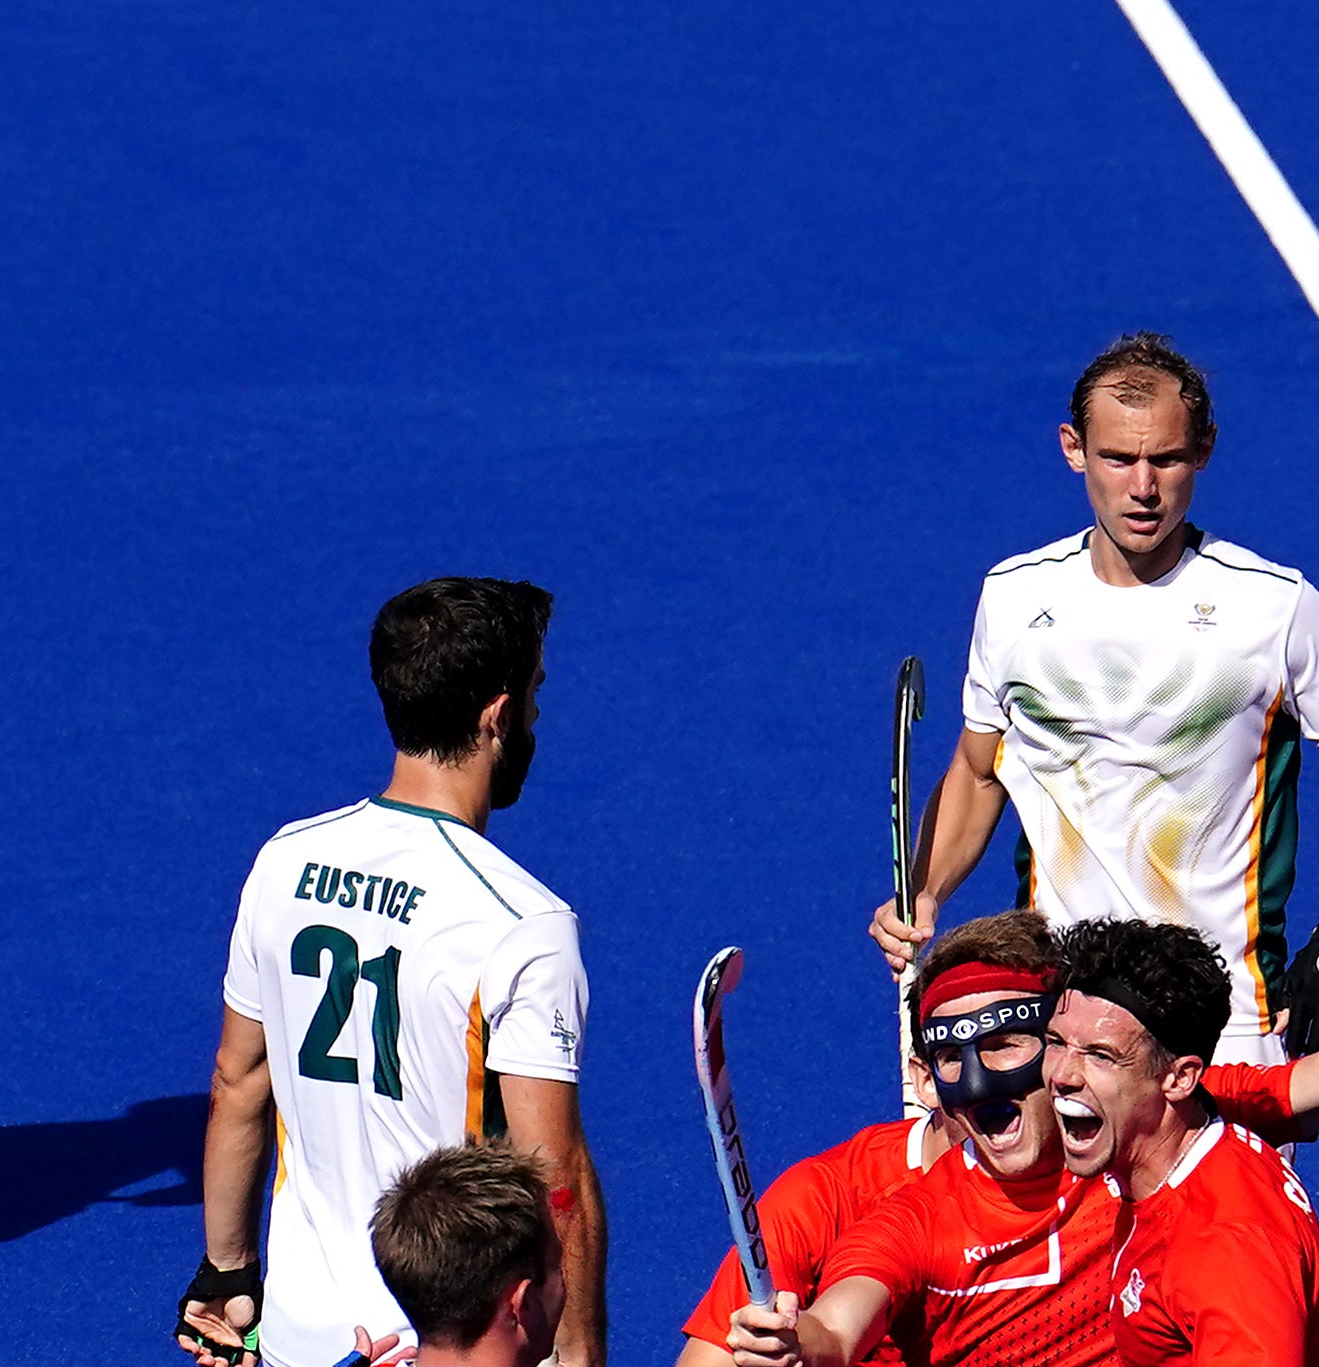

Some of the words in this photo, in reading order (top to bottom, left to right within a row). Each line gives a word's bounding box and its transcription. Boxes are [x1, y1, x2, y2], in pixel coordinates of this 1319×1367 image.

[294, 862, 417, 925] EUSTICE
[290, 924, 403, 1101] 21
[979, 1003, 1041, 1029] SPOT
